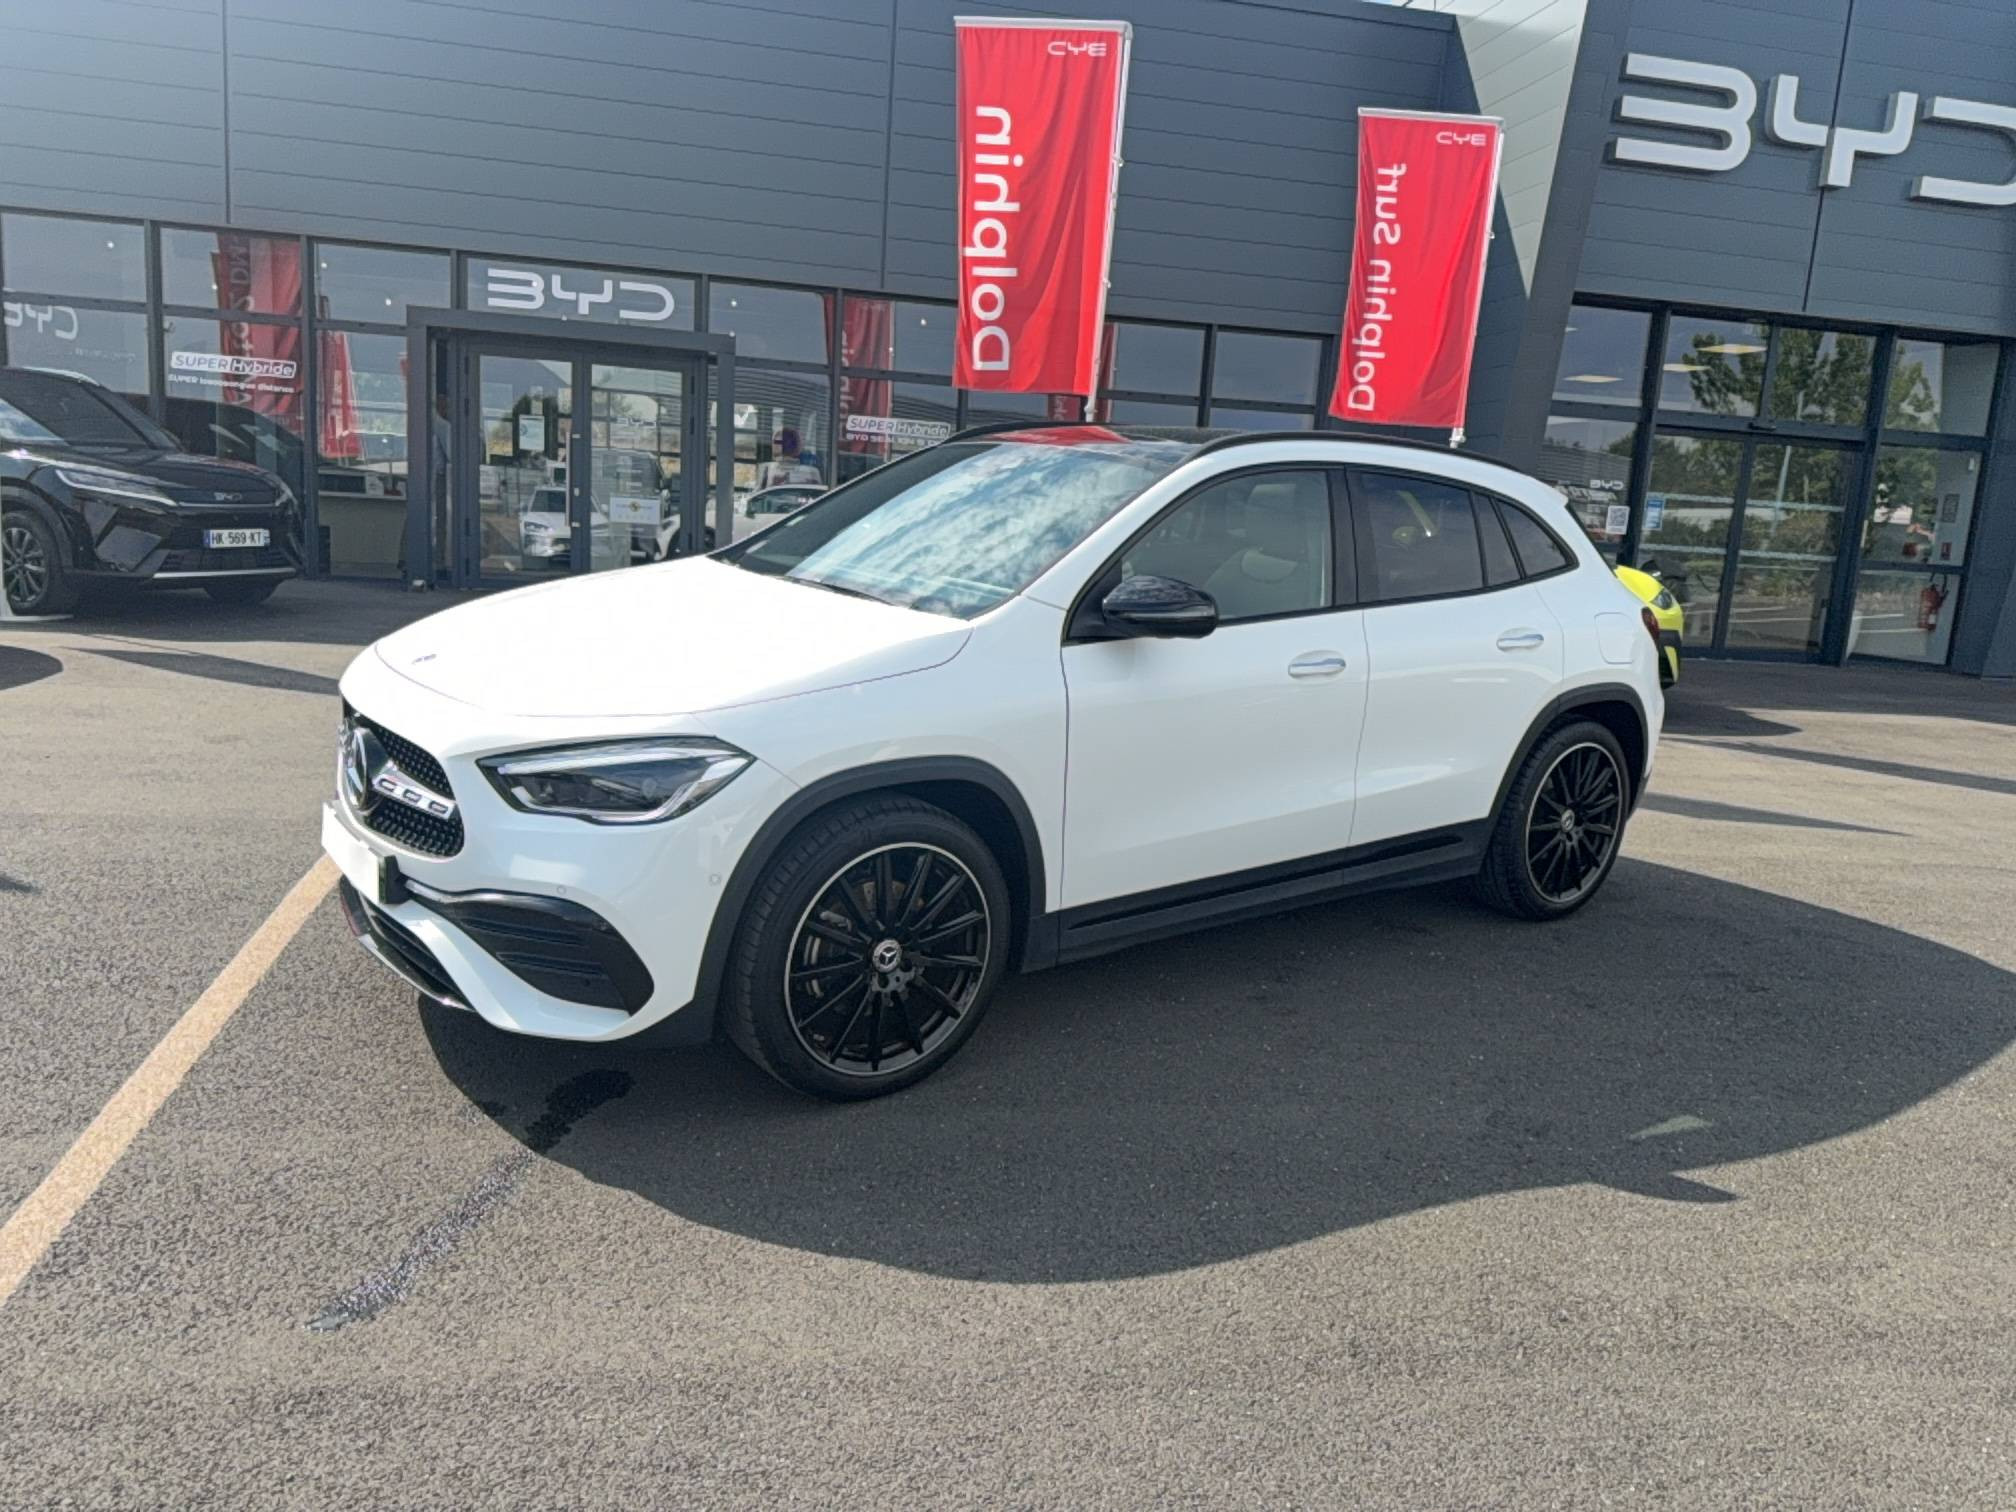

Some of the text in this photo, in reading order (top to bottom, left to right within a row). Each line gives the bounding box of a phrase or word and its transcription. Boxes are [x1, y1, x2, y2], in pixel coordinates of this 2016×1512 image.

[1610, 52, 2016, 206] BYD
[487, 267, 675, 321] BYD
[175, 355, 293, 376] SUPER Hybride
[850, 418, 894, 433] SUPER
